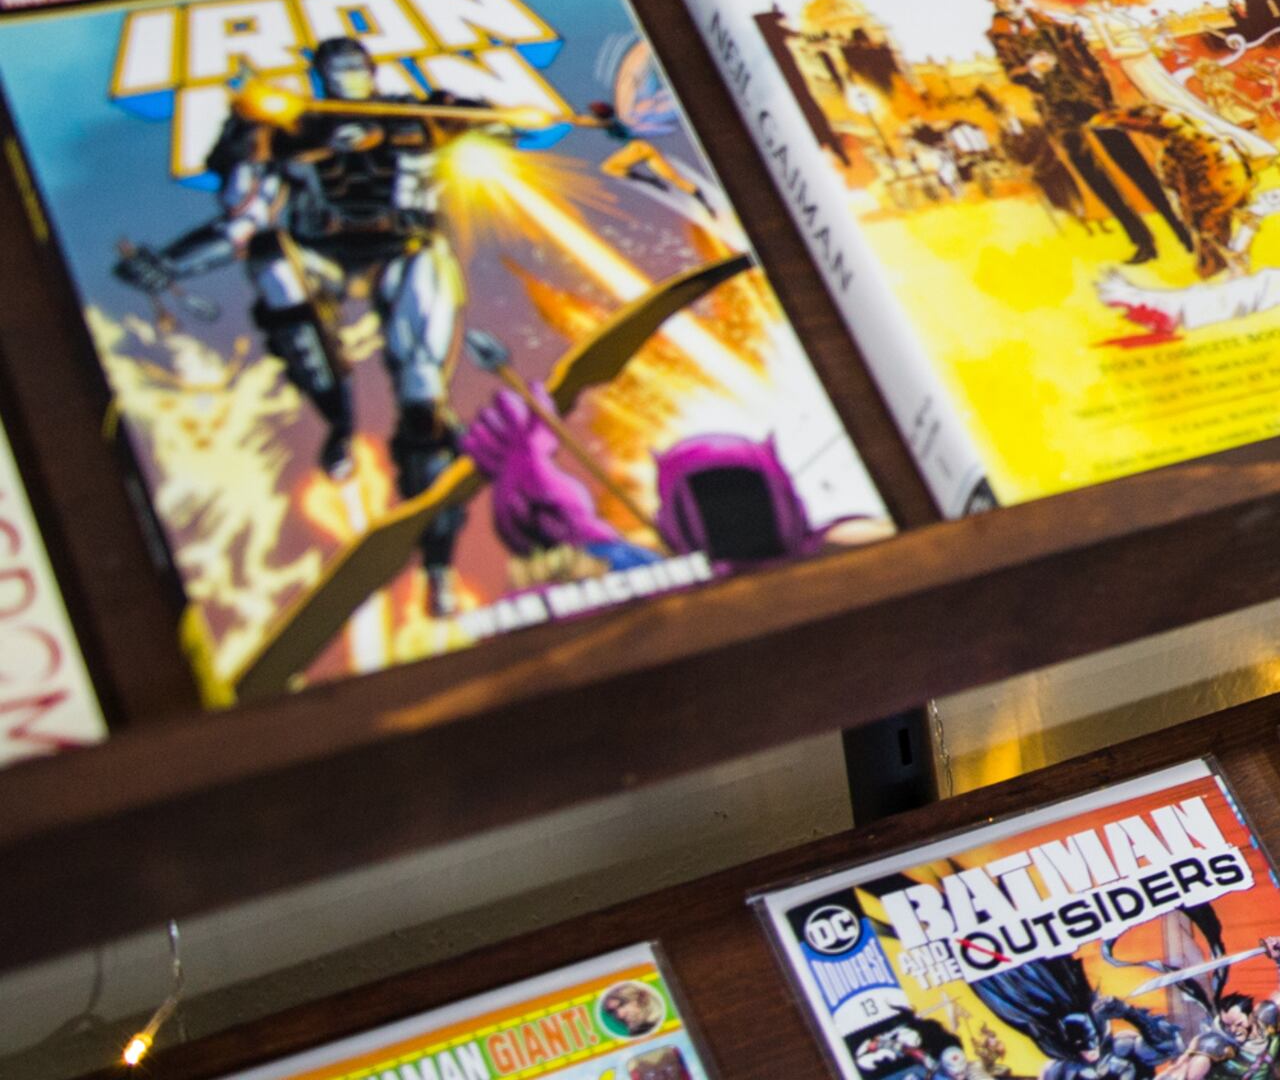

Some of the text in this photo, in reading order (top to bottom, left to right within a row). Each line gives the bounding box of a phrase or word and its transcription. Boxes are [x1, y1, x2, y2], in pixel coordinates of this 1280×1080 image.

[710, 10, 854, 295] NEIL GAIMAN
[879, 796, 1227, 950] BATMAN
[804, 913, 859, 941] DC
[960, 851, 1247, 973] OUTSIDERS
[815, 937, 900, 1003] UNIVERSE
[897, 940, 951, 971] AND
[911, 961, 964, 991] THE
[486, 1003, 600, 1075] GIANT!
[859, 998, 880, 1019] 13
